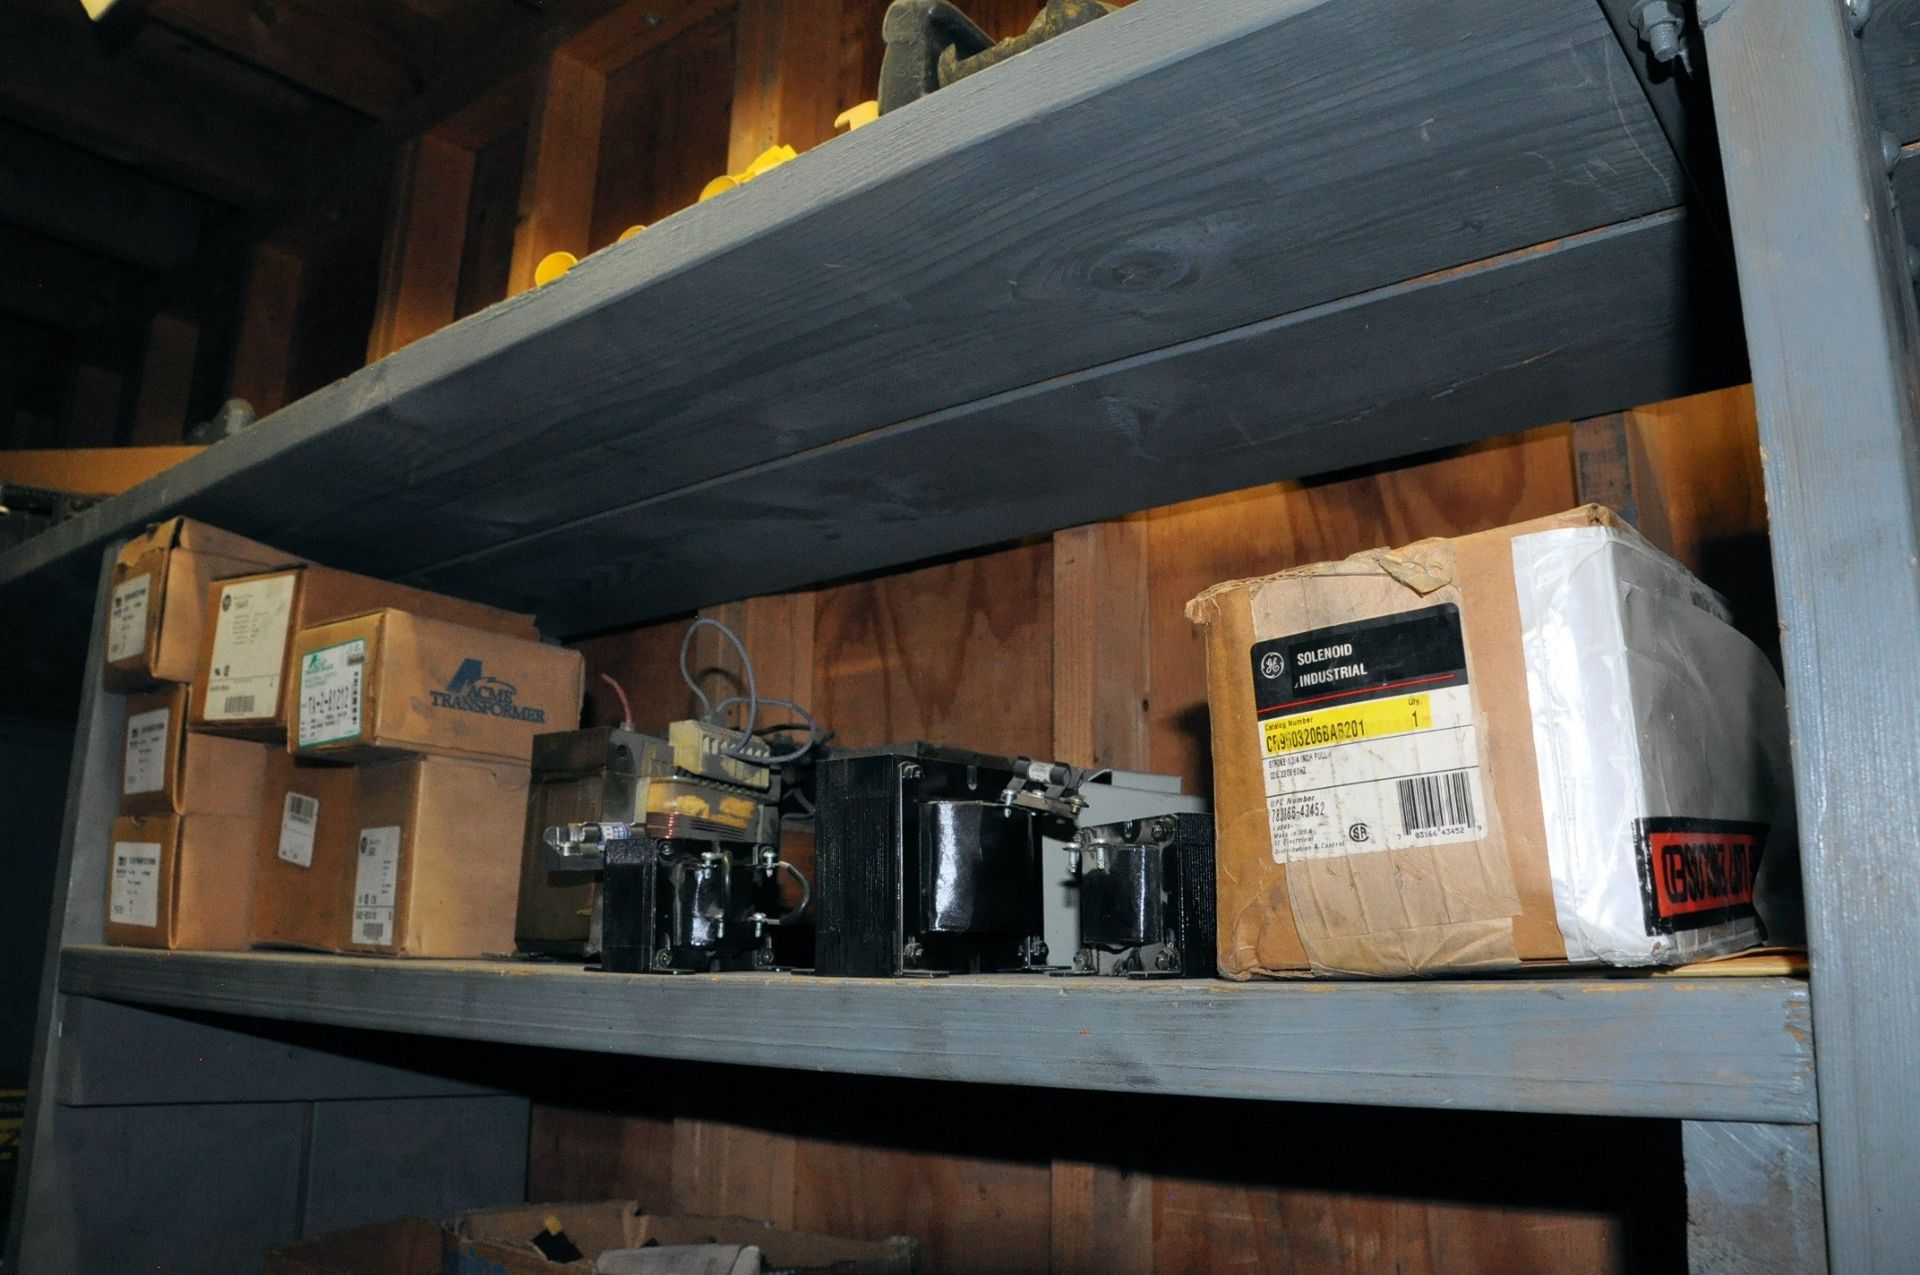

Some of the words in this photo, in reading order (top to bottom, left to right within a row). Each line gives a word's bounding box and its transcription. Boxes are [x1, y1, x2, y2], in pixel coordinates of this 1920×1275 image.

[1297, 643, 1353, 666] SOLENOID
[1300, 663, 1368, 688] INDUSTRIAL
[467, 684, 514, 705] ACME
[429, 690, 545, 724] TRANSFORMER
[1264, 721, 1287, 731] Catalog
[1288, 717, 1313, 727] Number
[1412, 710, 1418, 727] 1
[1270, 798, 1284, 808] UPC
[1287, 794, 1315, 805] Number
[1271, 801, 1325, 823] 783166-43452
[1441, 827, 1465, 837] 43452
